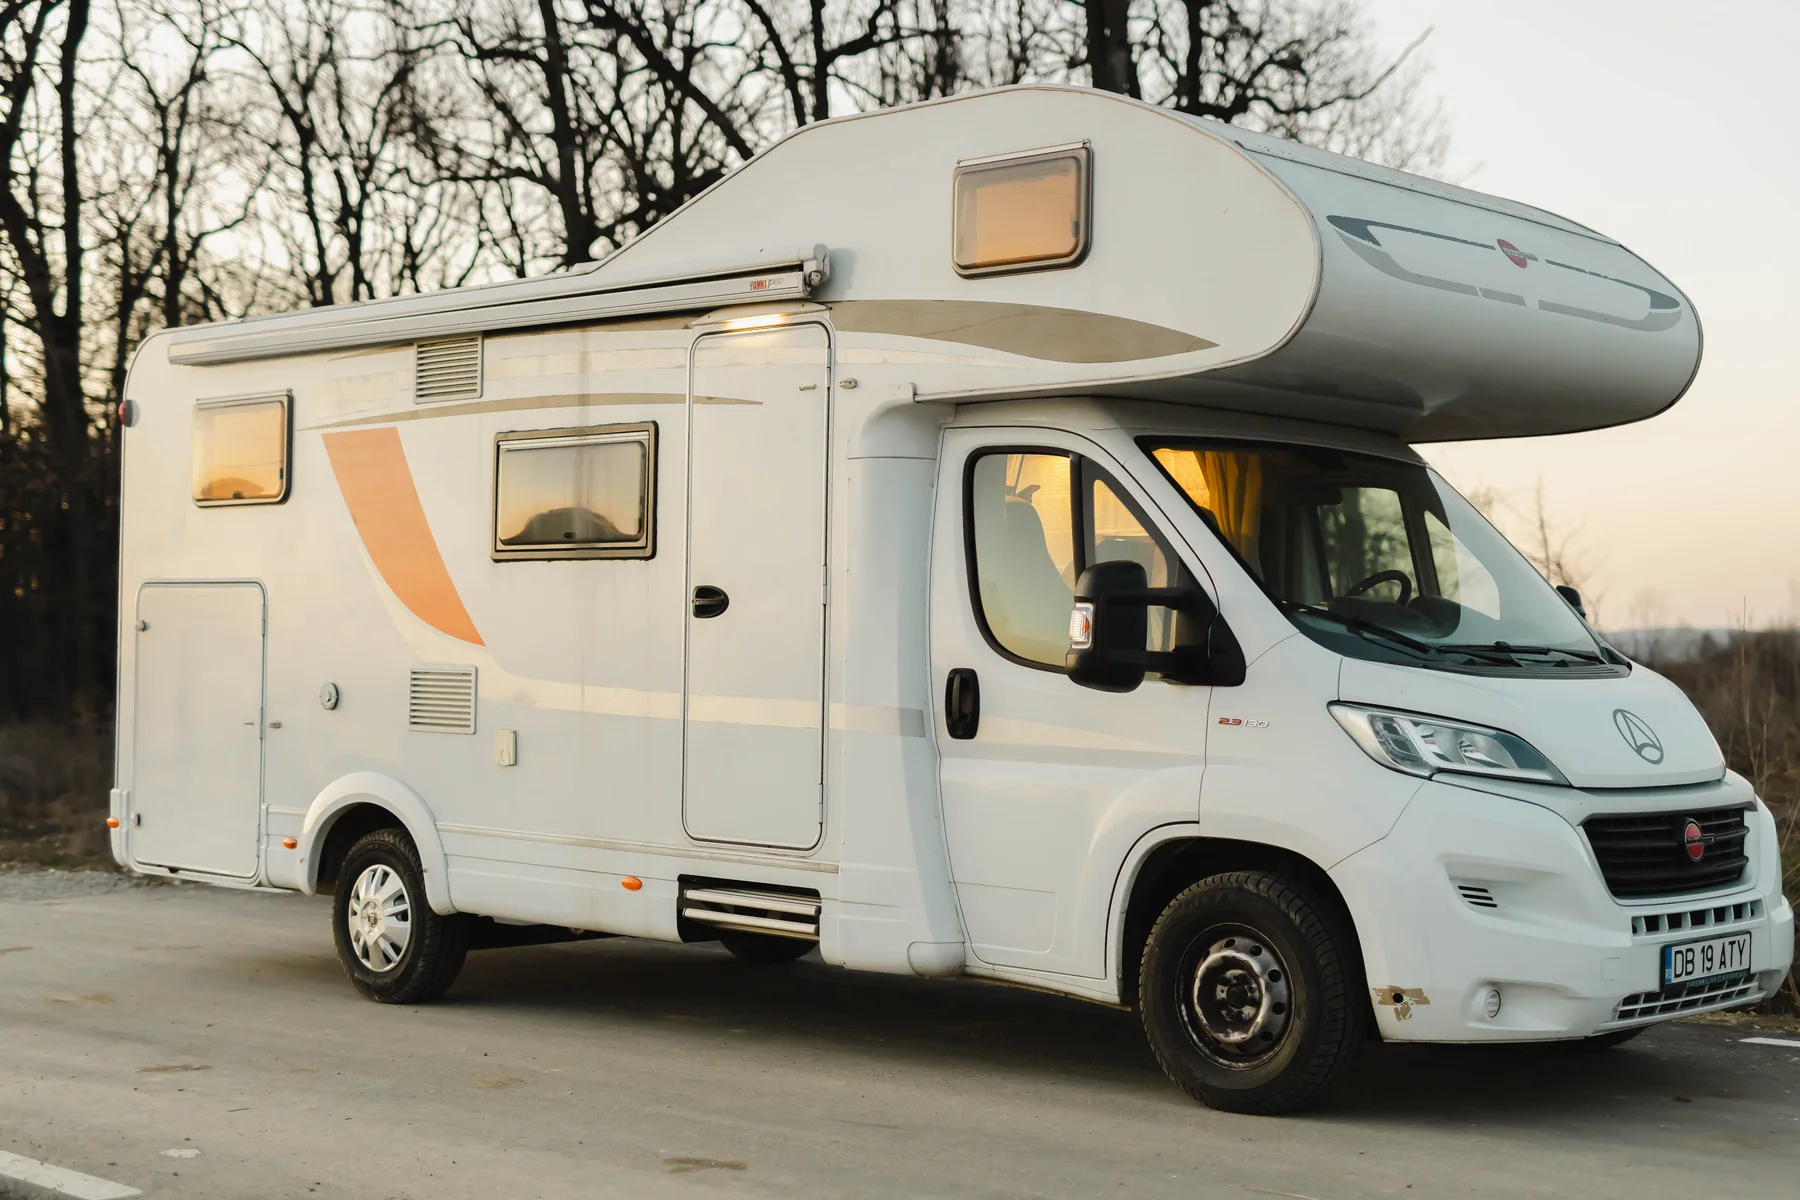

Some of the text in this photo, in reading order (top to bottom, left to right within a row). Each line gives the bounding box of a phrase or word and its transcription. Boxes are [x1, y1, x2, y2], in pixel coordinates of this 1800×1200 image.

[1244, 719, 1270, 729] 130
[1674, 947, 1695, 979] DB
[1701, 944, 1714, 973] 19
[1719, 938, 1747, 970] ATY
